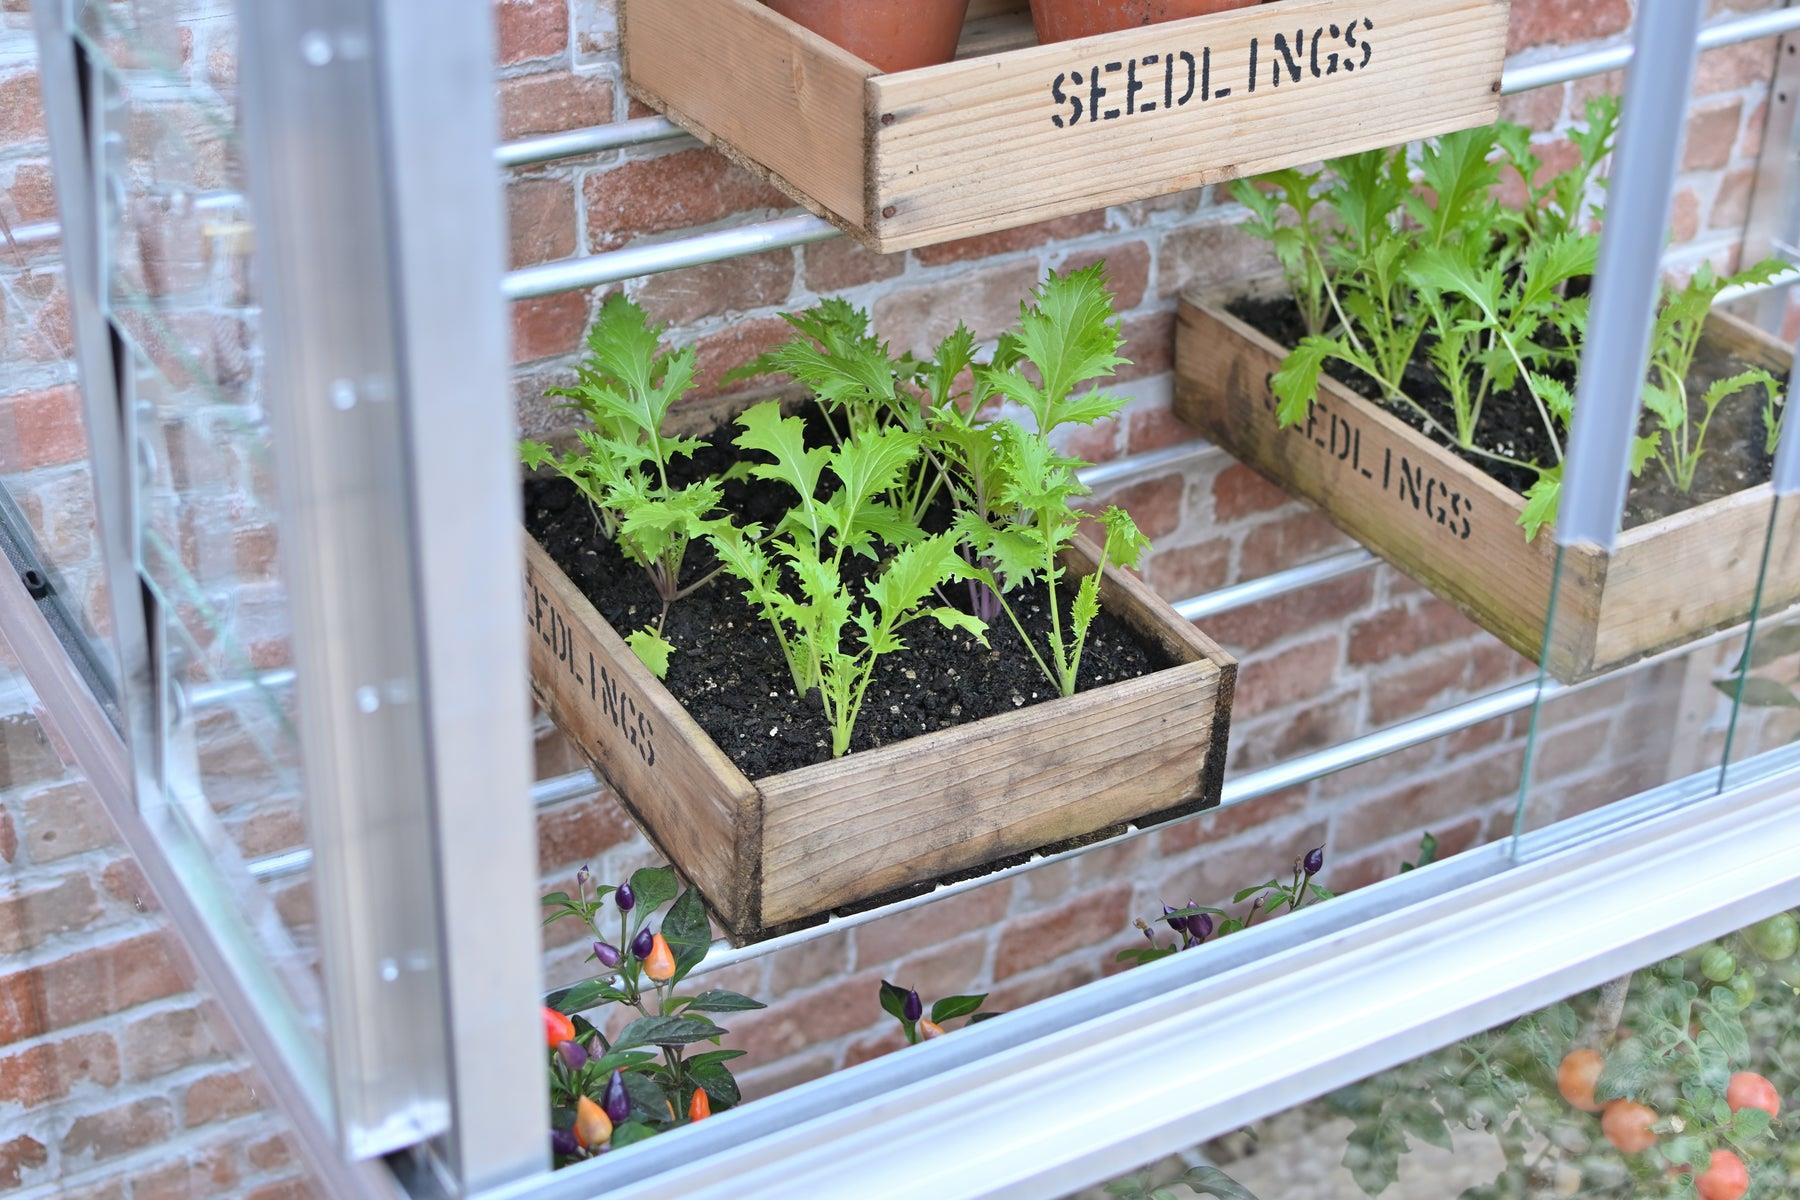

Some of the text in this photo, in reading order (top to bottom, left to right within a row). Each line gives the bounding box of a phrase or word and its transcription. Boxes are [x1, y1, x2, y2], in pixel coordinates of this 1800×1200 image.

[1052, 17, 1374, 128] SEEDLINGS
[1264, 371, 1472, 540] SEDLINGS
[525, 574, 655, 767] EDLINGS
